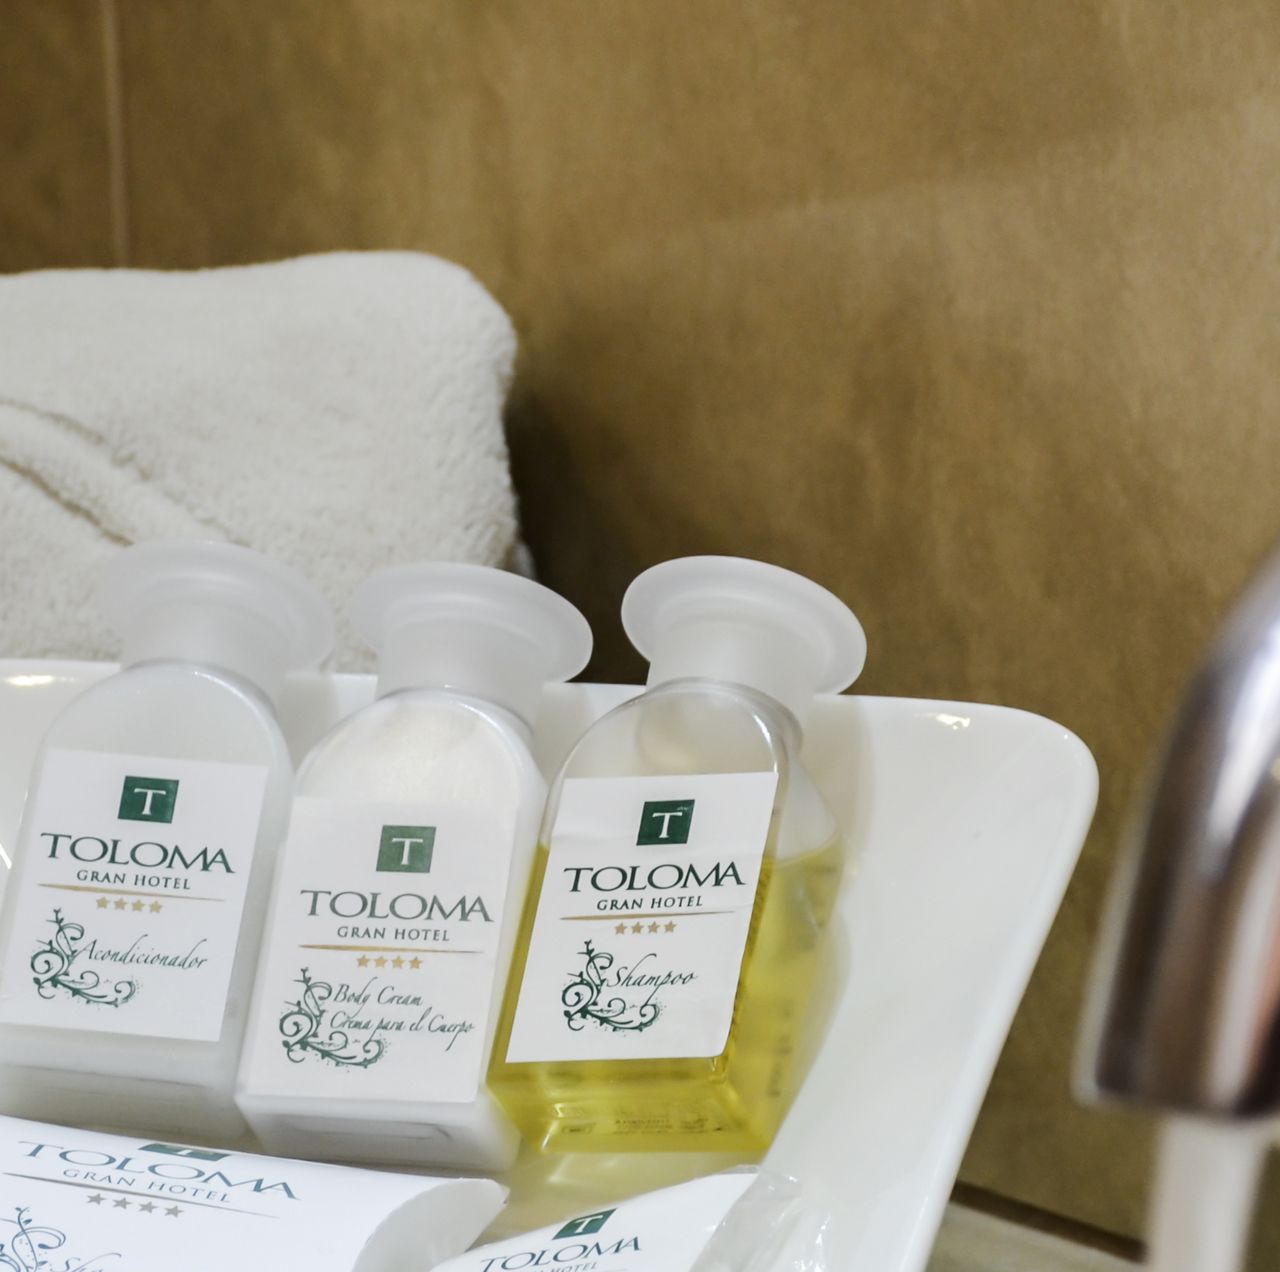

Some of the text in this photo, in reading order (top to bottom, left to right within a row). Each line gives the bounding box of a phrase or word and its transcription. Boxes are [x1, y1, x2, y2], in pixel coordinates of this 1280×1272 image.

[134, 787, 167, 815] T
[652, 812, 683, 839] T
[40, 832, 236, 874] TOLOMA
[391, 837, 424, 866] T
[76, 869, 191, 890] GRAN HOTEL
[563, 861, 746, 893] TOLOMA
[300, 889, 495, 923] TOLOMA
[596, 895, 703, 911] GRAN HOTEL
[336, 925, 451, 942] GRAN HOTEL
[74, 933, 209, 969] Acondicionador
[606, 953, 698, 1006] Shampoo
[333, 976, 423, 1019] Body Cream
[330, 1006, 475, 1052] Crema para el Cuerpo
[18, 1140, 302, 1201] TOLOMA
[63, 1168, 231, 1203] GRAN HOTEL
[574, 1214, 604, 1234] T
